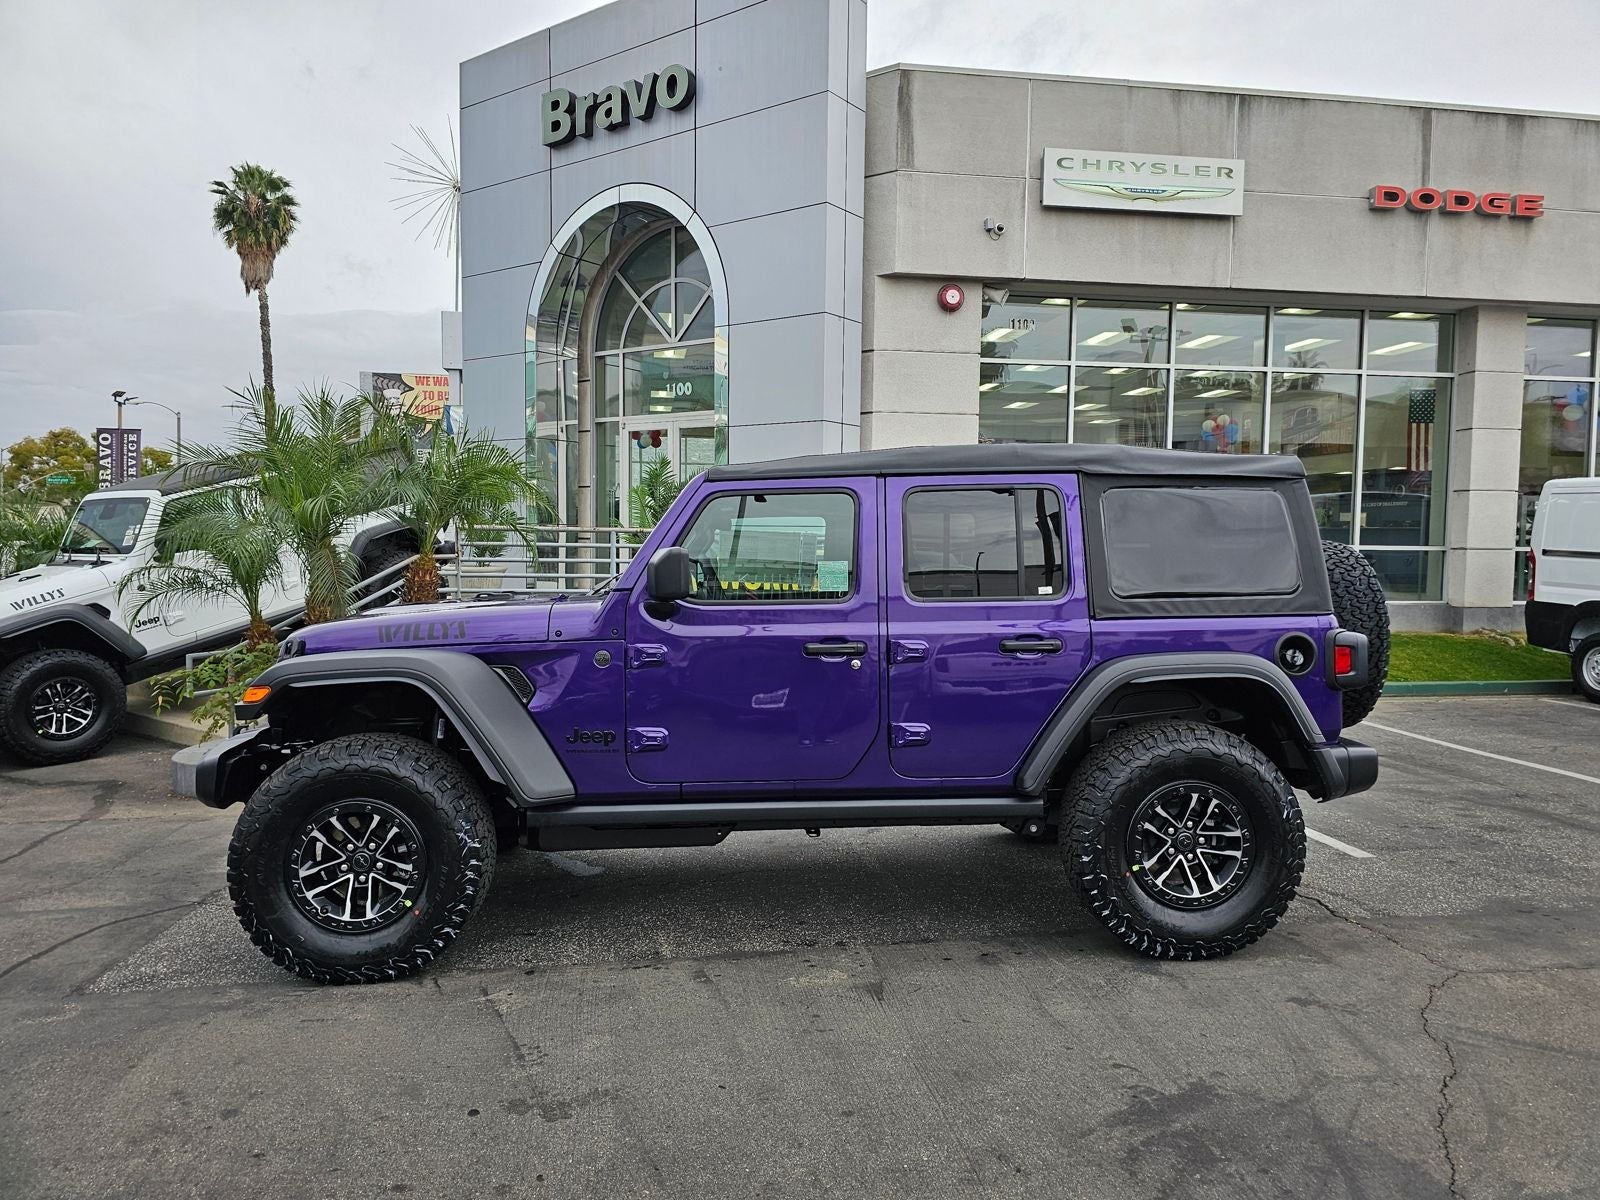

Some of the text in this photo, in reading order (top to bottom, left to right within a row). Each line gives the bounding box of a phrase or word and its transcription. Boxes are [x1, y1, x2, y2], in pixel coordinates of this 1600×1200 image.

[541, 63, 695, 148] Bravo
[1056, 156, 1235, 179] CHRYSLER
[1372, 184, 1545, 218] DODGE
[415, 375, 431, 387] WE
[665, 382, 693, 399] 1100
[422, 390, 435, 401] TO
[128, 433, 137, 480] RVICE
[9, 587, 66, 611] WILLYS
[134, 616, 160, 628] Jeep
[377, 620, 471, 643] WILLYS
[566, 726, 617, 747] Jeep
